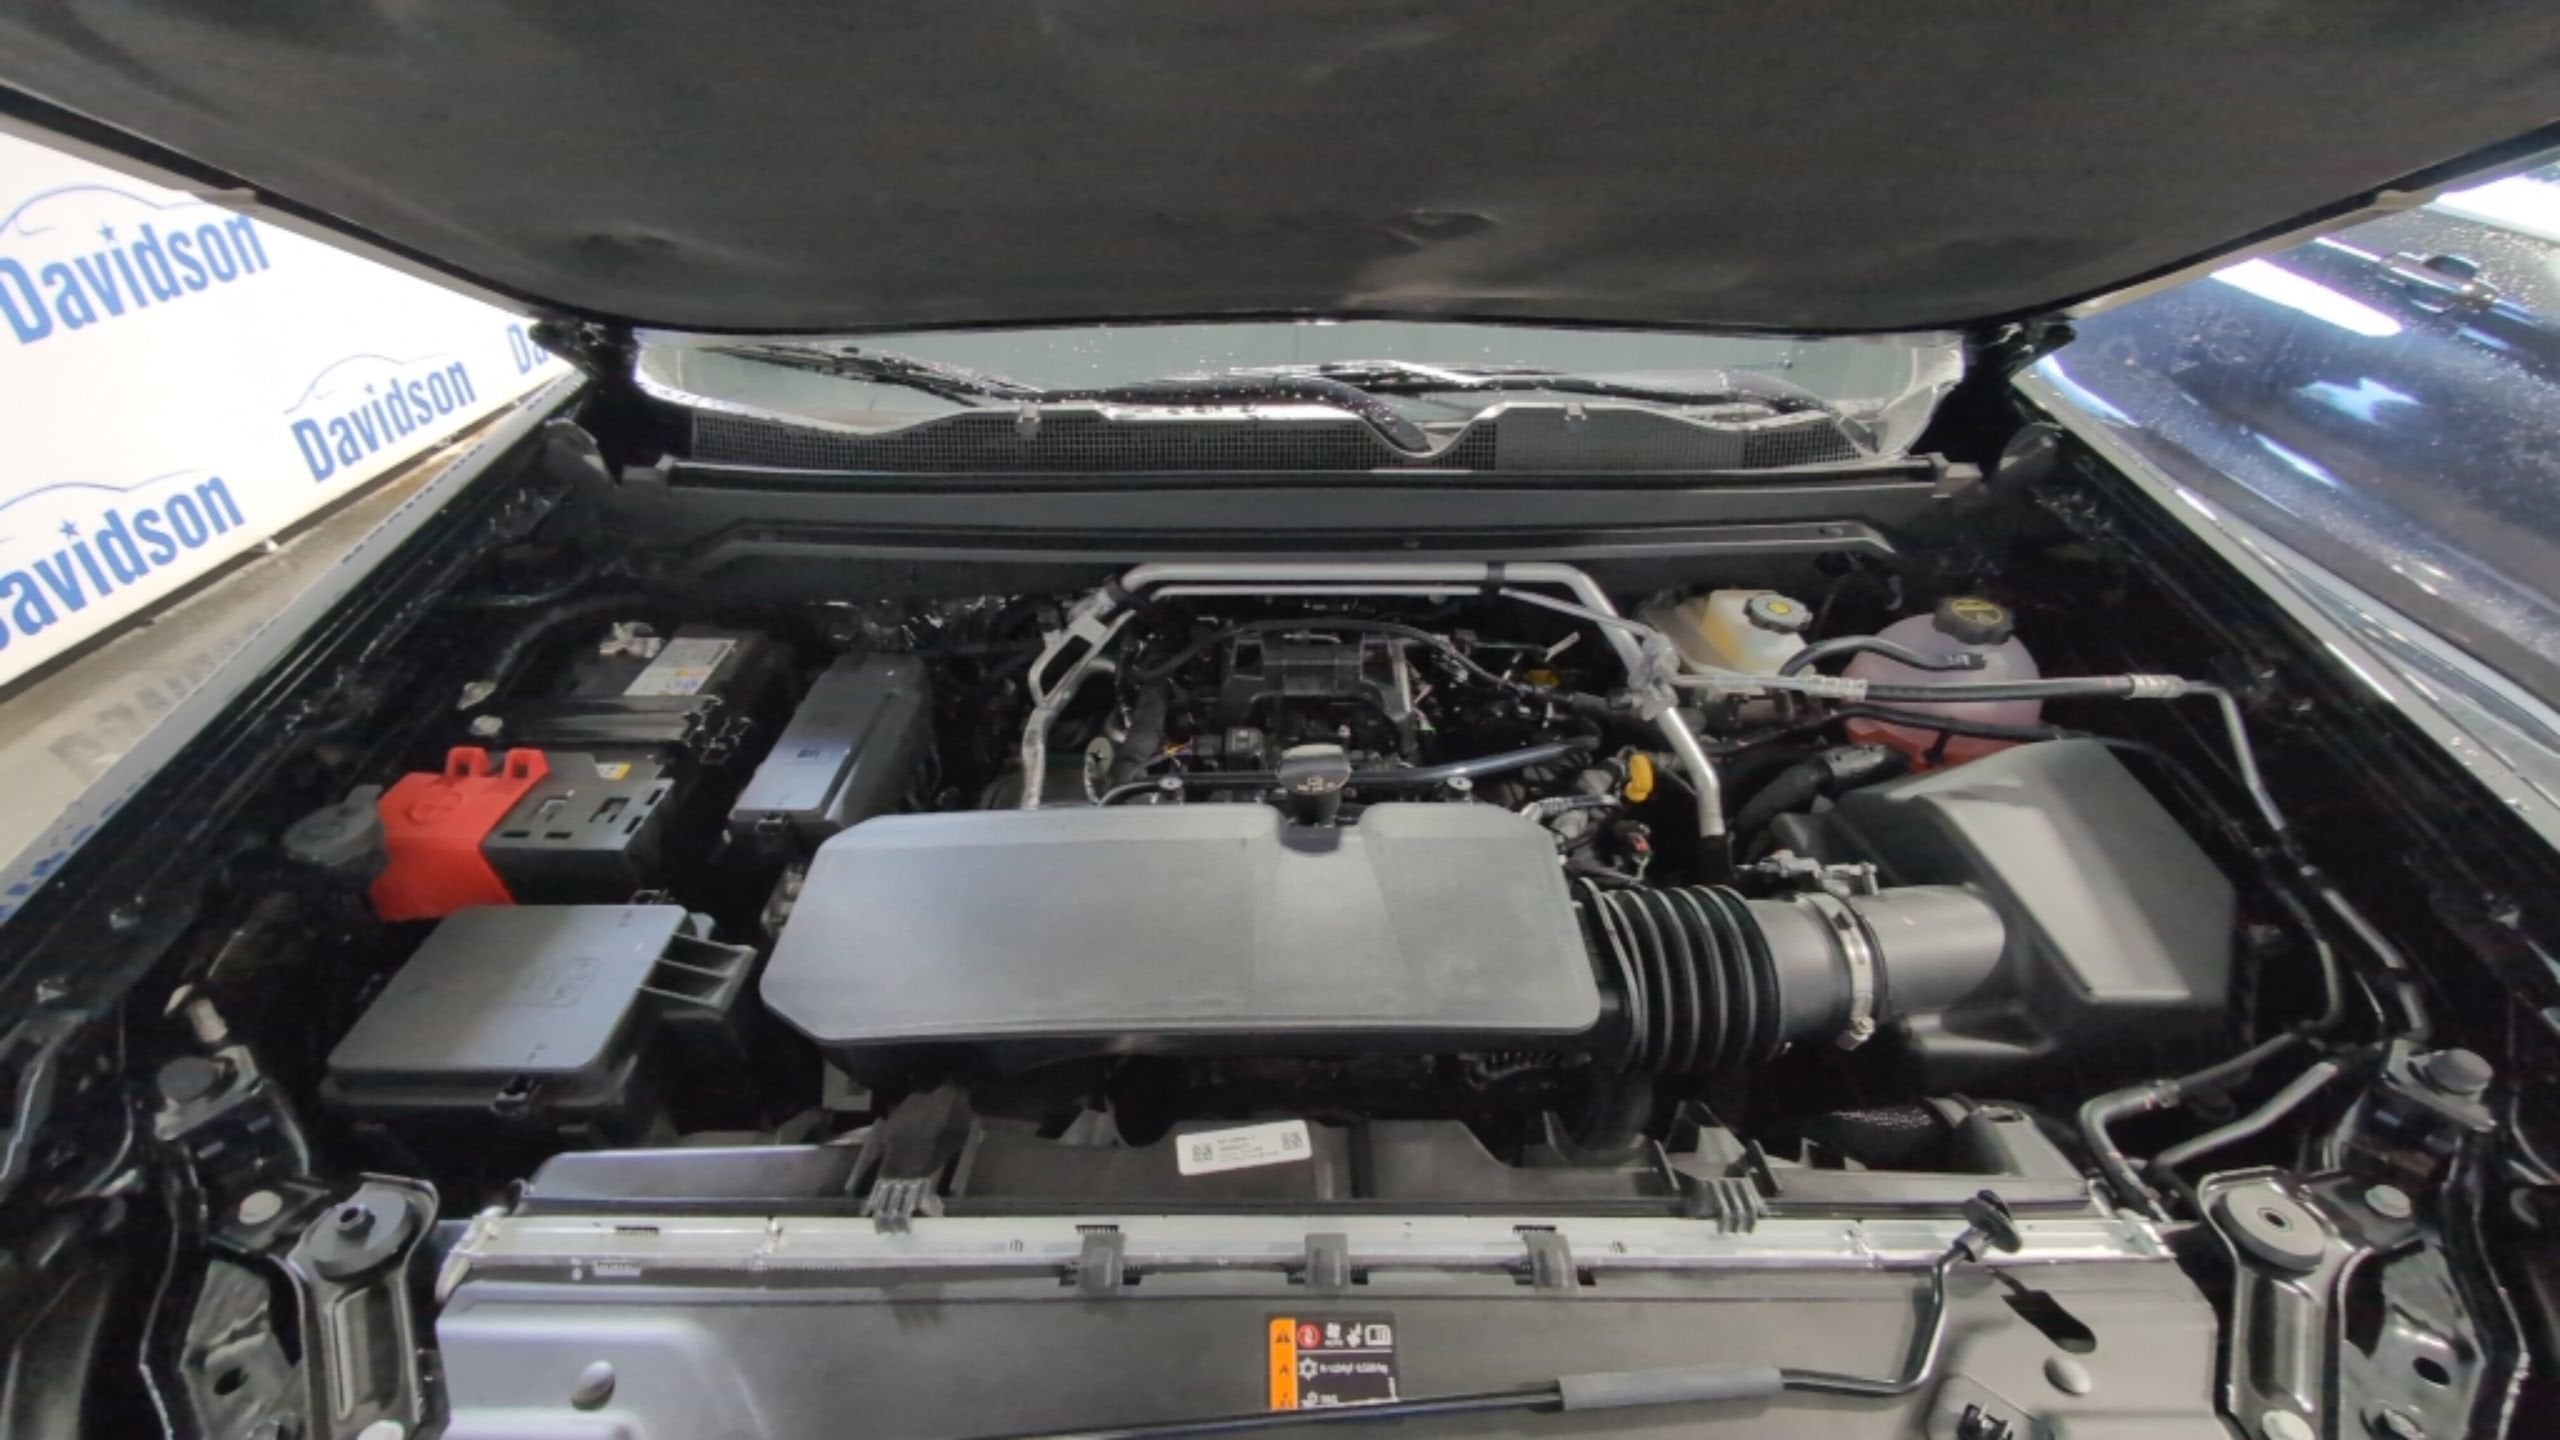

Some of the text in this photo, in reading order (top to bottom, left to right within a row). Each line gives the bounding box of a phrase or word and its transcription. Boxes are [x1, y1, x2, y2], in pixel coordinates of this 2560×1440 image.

[0, 213, 270, 344] Davidson
[291, 360, 478, 483] Davidson
[0, 476, 245, 650] avidson
